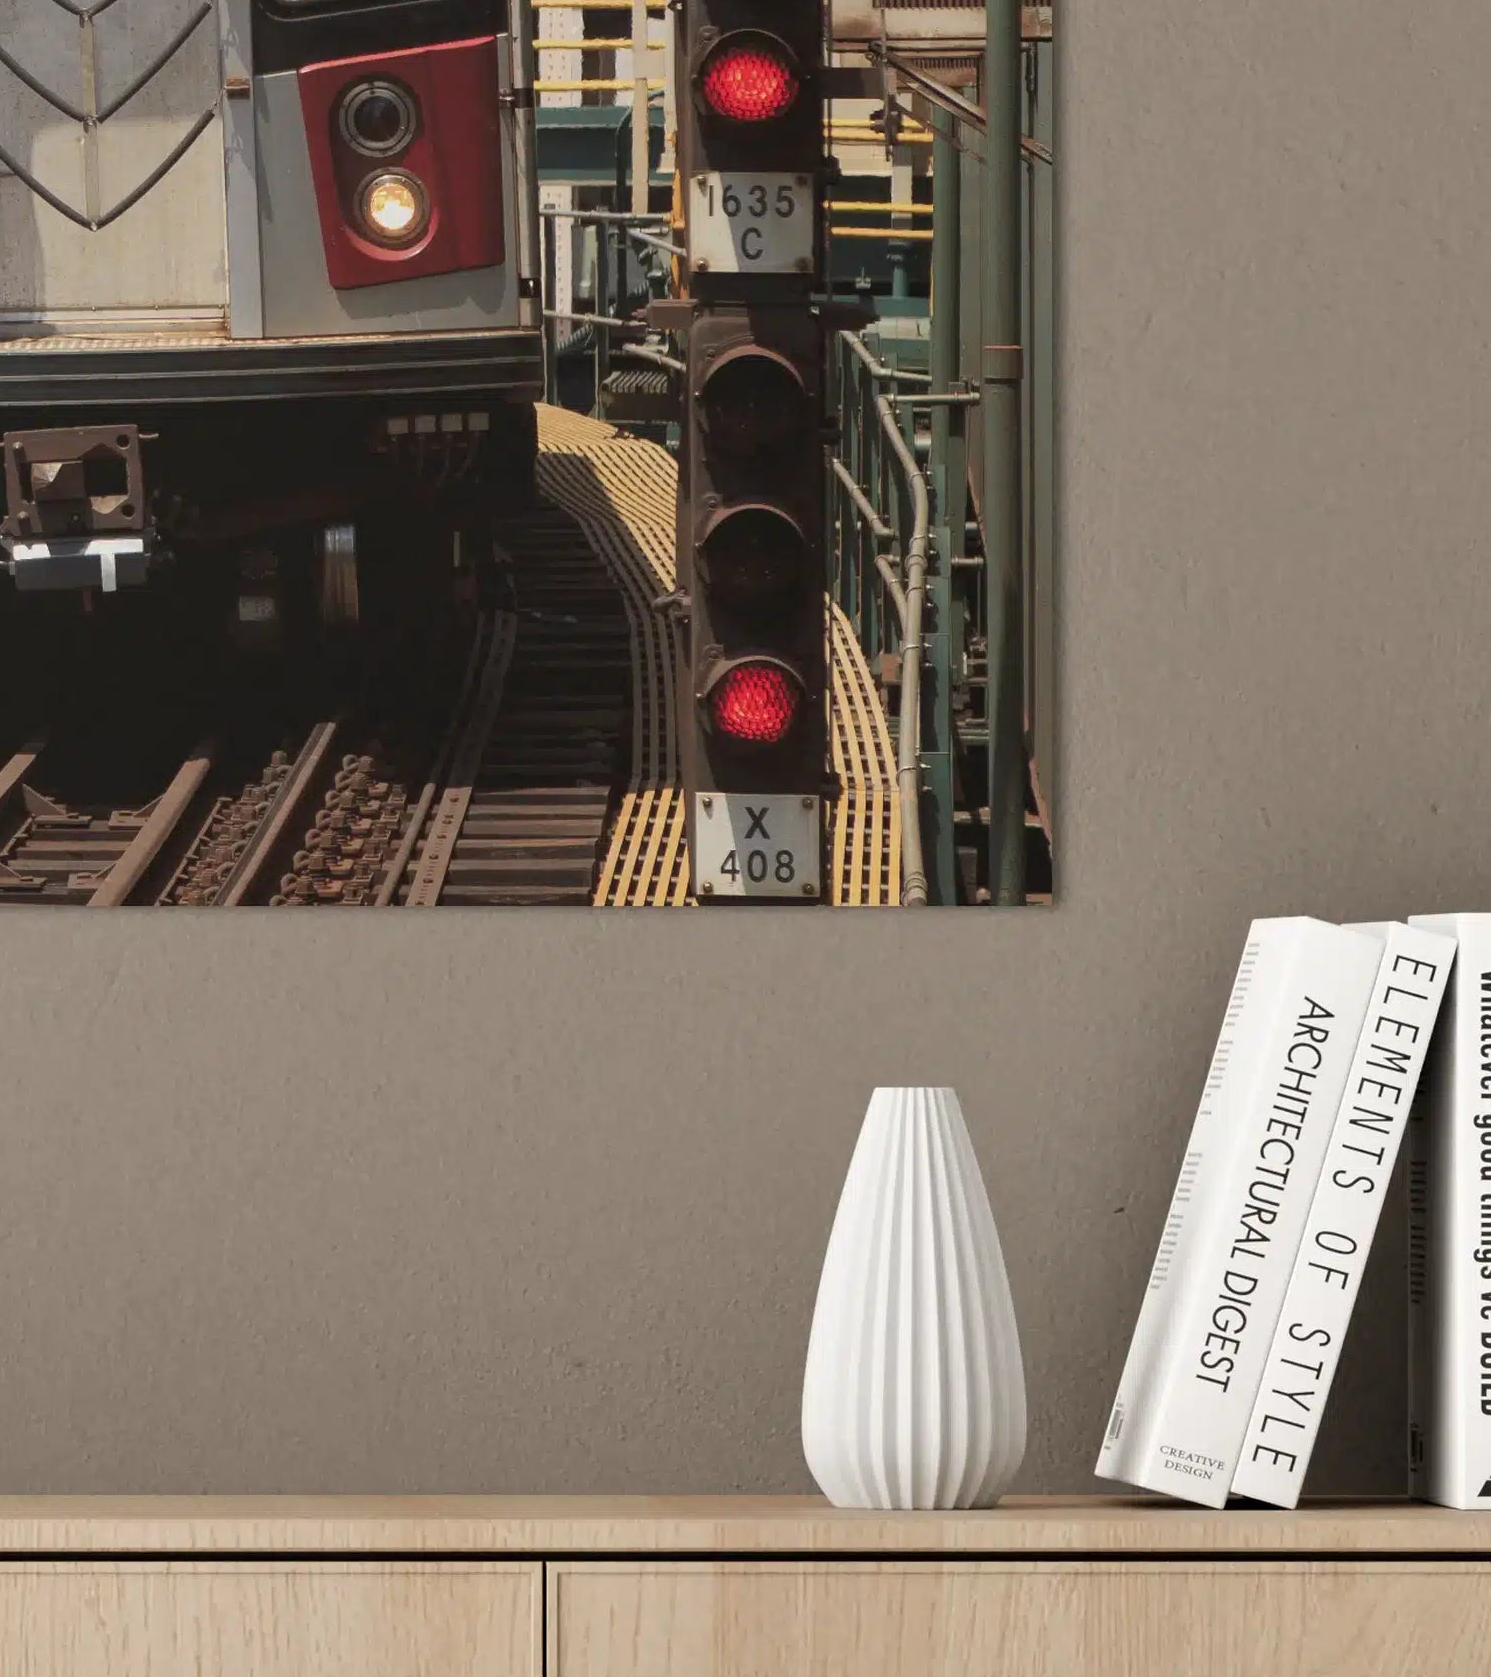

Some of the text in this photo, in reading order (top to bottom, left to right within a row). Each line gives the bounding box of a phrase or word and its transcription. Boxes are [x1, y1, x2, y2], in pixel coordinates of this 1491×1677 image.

[708, 183, 796, 218] 1635
[740, 226, 765, 261] C
[743, 805, 772, 840] X
[720, 849, 796, 884] 408
[1195, 995, 1336, 1393] ARCHITECTURAL DIGEST
[1252, 954, 1438, 1473] ELEMENTS OF STYLE
[1159, 1444, 1226, 1471] CREATIVE
[1164, 1459, 1214, 1481] DESIGN
